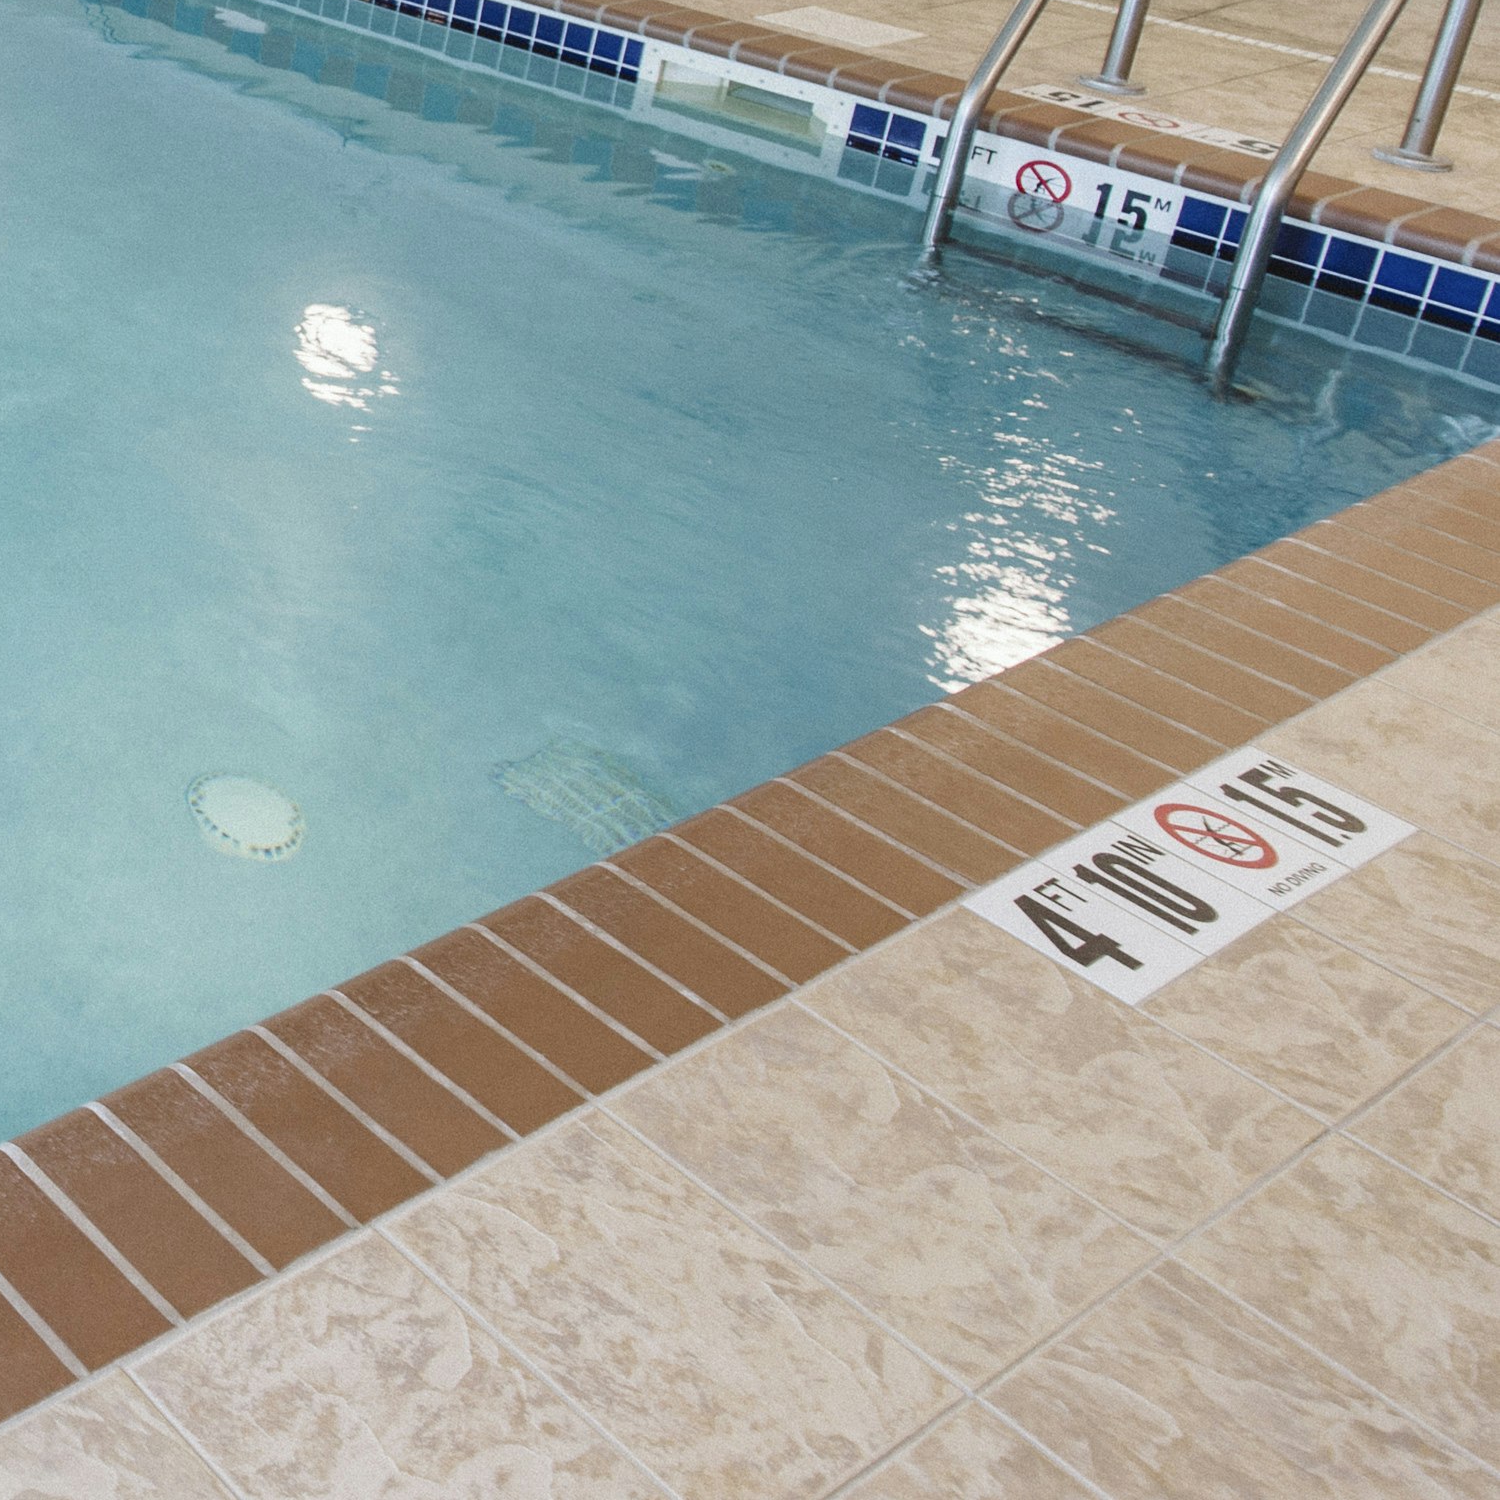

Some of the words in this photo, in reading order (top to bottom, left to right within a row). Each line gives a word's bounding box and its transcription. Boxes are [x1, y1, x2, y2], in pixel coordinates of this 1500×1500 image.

[971, 145, 998, 165] FT
[1154, 197, 1172, 213] M
[1258, 759, 1298, 780] M
[1111, 834, 1167, 866] IN
[1034, 876, 1089, 912] FT
[1072, 851, 1220, 936] 10
[1267, 880, 1288, 898] NO
[1286, 861, 1328, 887] DIVING
[1013, 893, 1145, 972] 4
